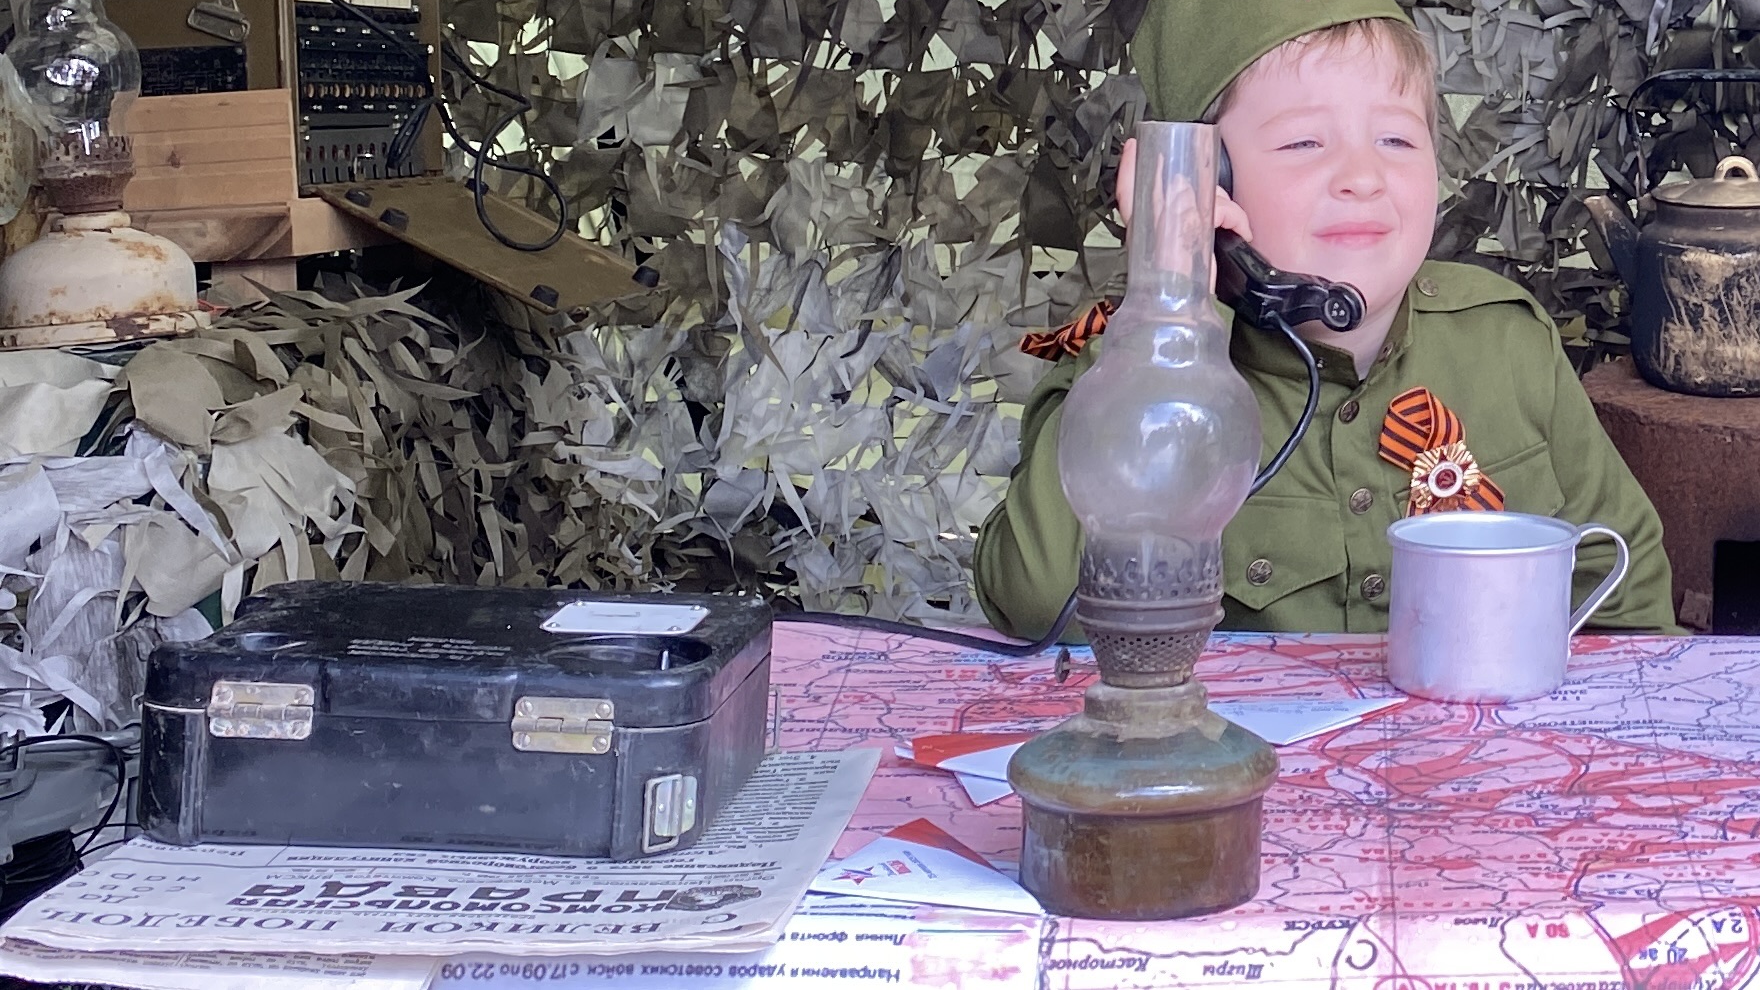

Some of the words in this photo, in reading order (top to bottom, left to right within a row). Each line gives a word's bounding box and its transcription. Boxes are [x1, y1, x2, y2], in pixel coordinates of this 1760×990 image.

[77, 894, 141, 904] Да
[240, 881, 678, 903] ПРАВДА
[225, 898, 668, 914] КОМСОМОЛЬСКАЯ
[375, 921, 664, 936] ВЕЛИКОЙ
[1526, 923, 1539, 939] А
[1711, 919, 1725, 934] А
[1730, 919, 1743, 934] 2
[790, 931, 848, 944] фронта
[856, 933, 906, 946] Линия
[442, 963, 496, 980] 22.09
[587, 963, 635, 980] войск
[640, 963, 723, 979] советских
[728, 962, 786, 978] ударов
[1047, 954, 1150, 973] Касторное
[1202, 960, 1265, 981] Шигры
[790, 965, 900, 984] Направления
